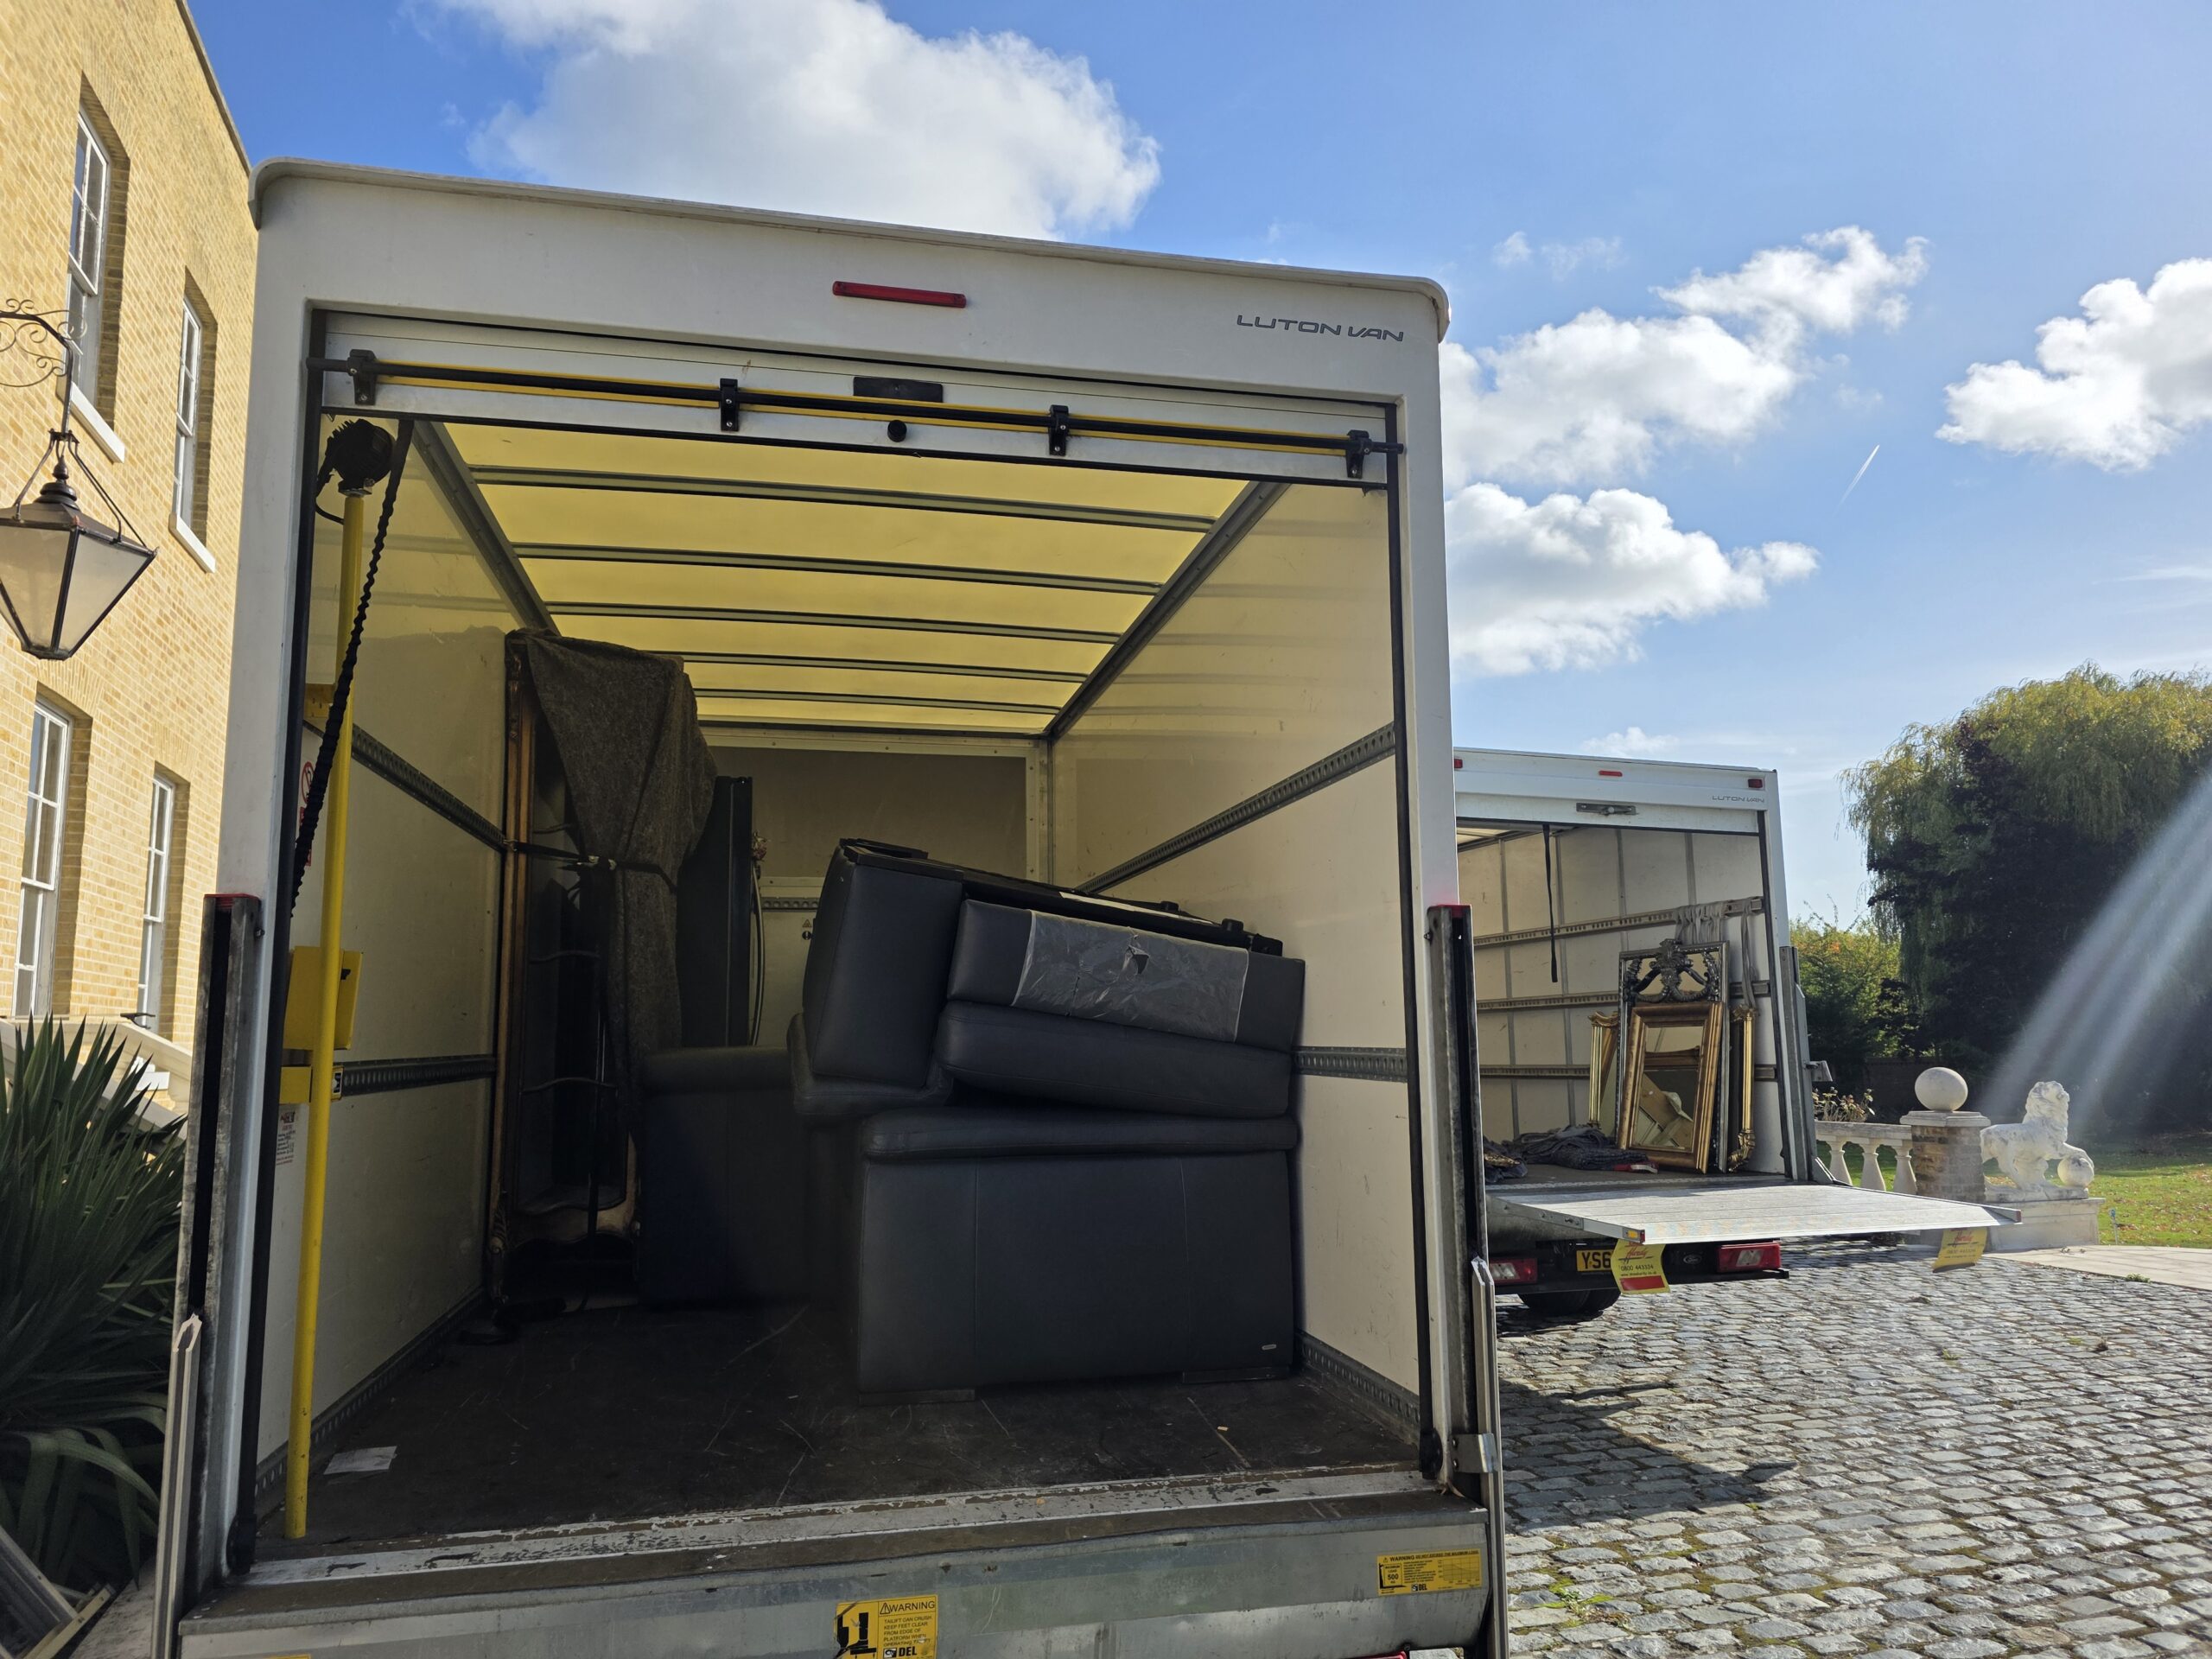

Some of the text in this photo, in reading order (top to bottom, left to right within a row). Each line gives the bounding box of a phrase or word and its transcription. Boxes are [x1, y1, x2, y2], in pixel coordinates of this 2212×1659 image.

[1236, 315, 1404, 342] LUTON VAN
[889, 1601, 935, 1612] WARNING
[899, 1646, 917, 1656] DEL
